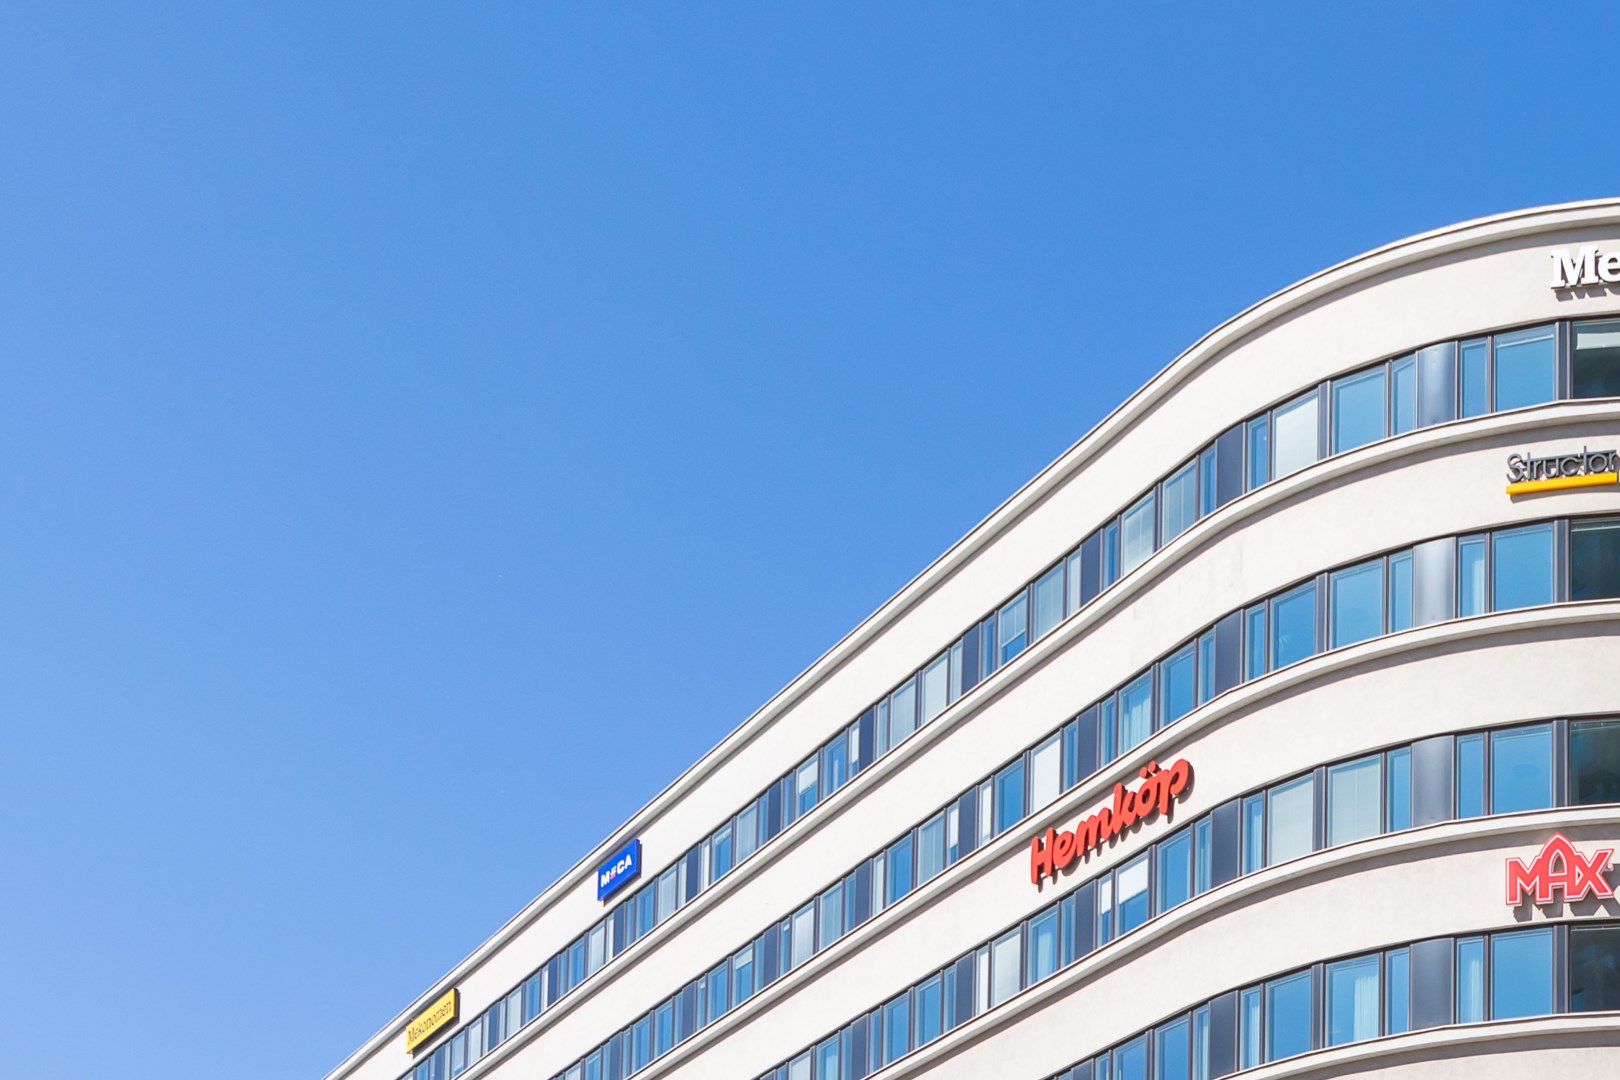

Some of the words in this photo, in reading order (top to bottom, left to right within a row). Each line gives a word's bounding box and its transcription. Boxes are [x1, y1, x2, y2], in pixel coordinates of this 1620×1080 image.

[1506, 445, 1617, 483] Structor
[1030, 758, 1190, 885] Hemköp
[1506, 832, 1614, 906] MAX
